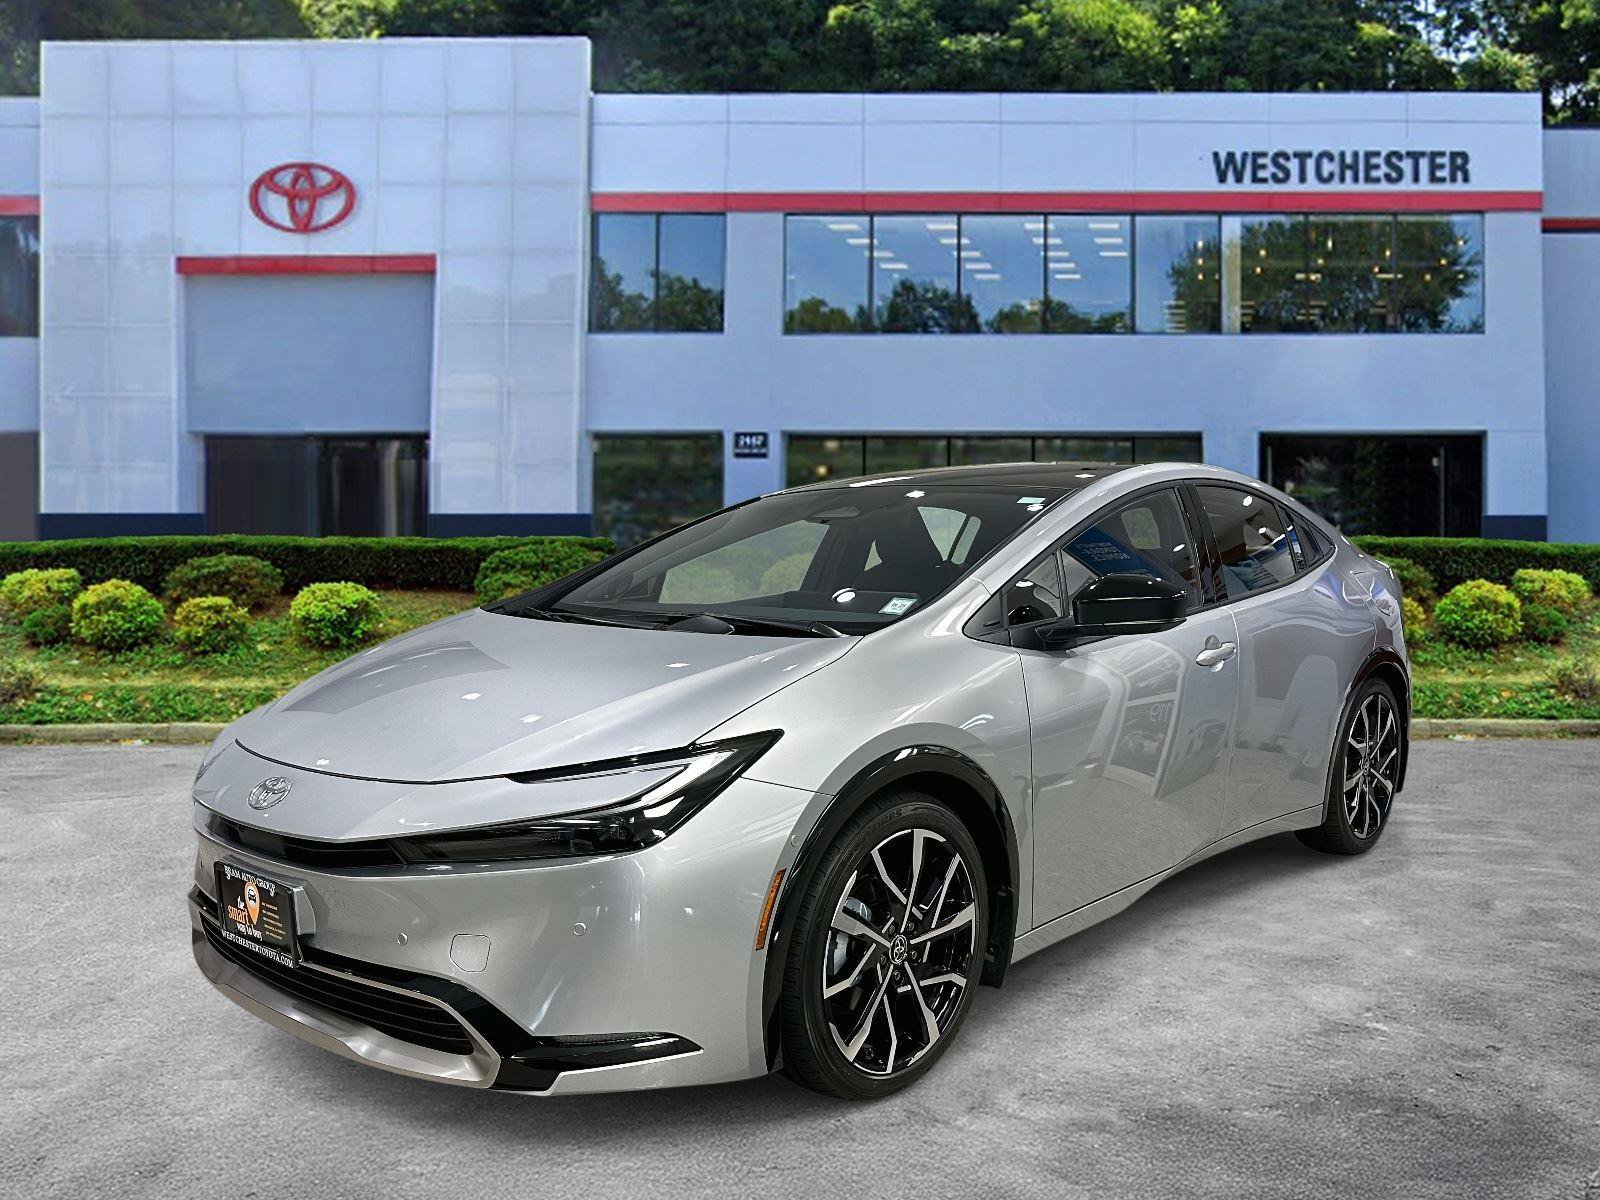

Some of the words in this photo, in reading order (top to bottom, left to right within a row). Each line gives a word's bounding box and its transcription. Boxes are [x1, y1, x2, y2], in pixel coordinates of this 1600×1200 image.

[1212, 150, 1471, 184] WESTCHESTER
[227, 905, 249, 925] smart
[222, 929, 294, 968] WESTCHESTERTOYOTA.COM
